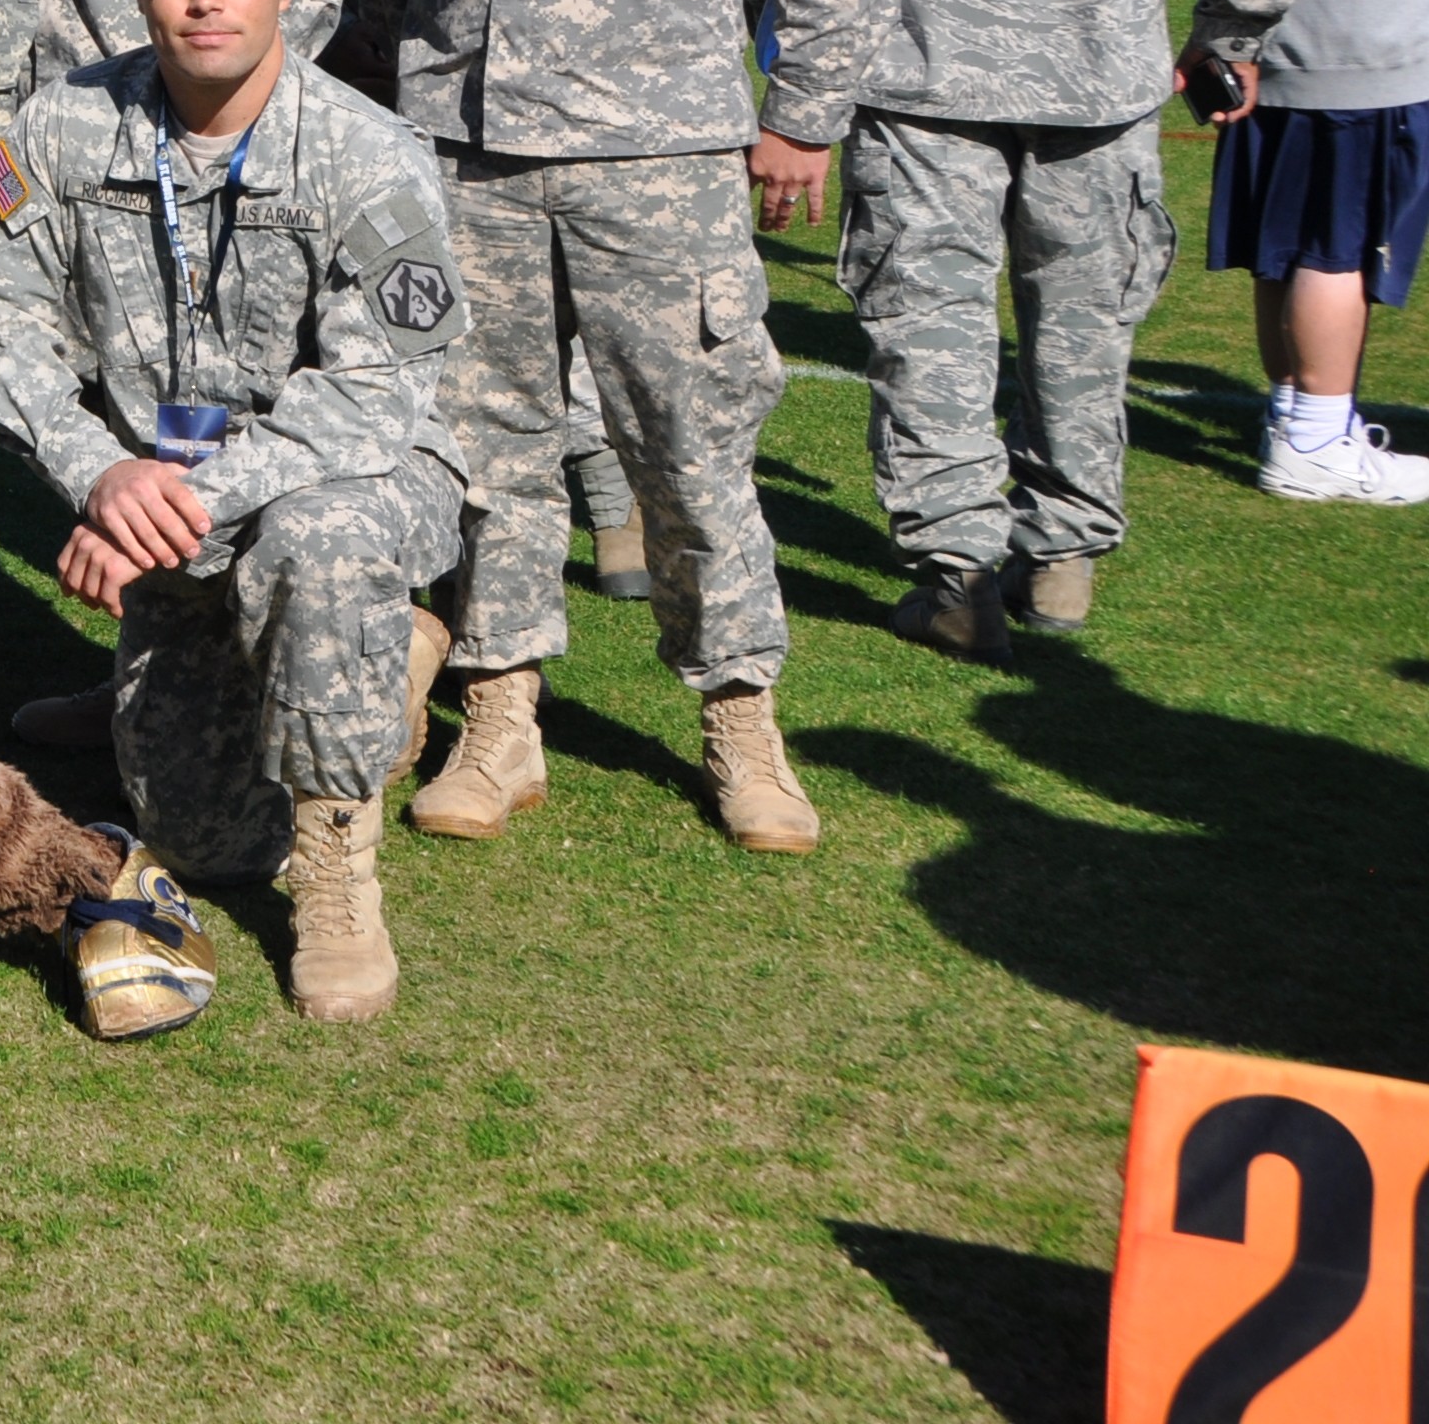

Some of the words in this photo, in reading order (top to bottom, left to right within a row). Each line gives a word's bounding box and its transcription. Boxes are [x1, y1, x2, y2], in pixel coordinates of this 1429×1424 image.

[238, 206, 260, 224] U.S.
[264, 206, 314, 226] ARMY
[412, 294, 428, 313] 3
[1165, 1094, 1429, 1424] 2
